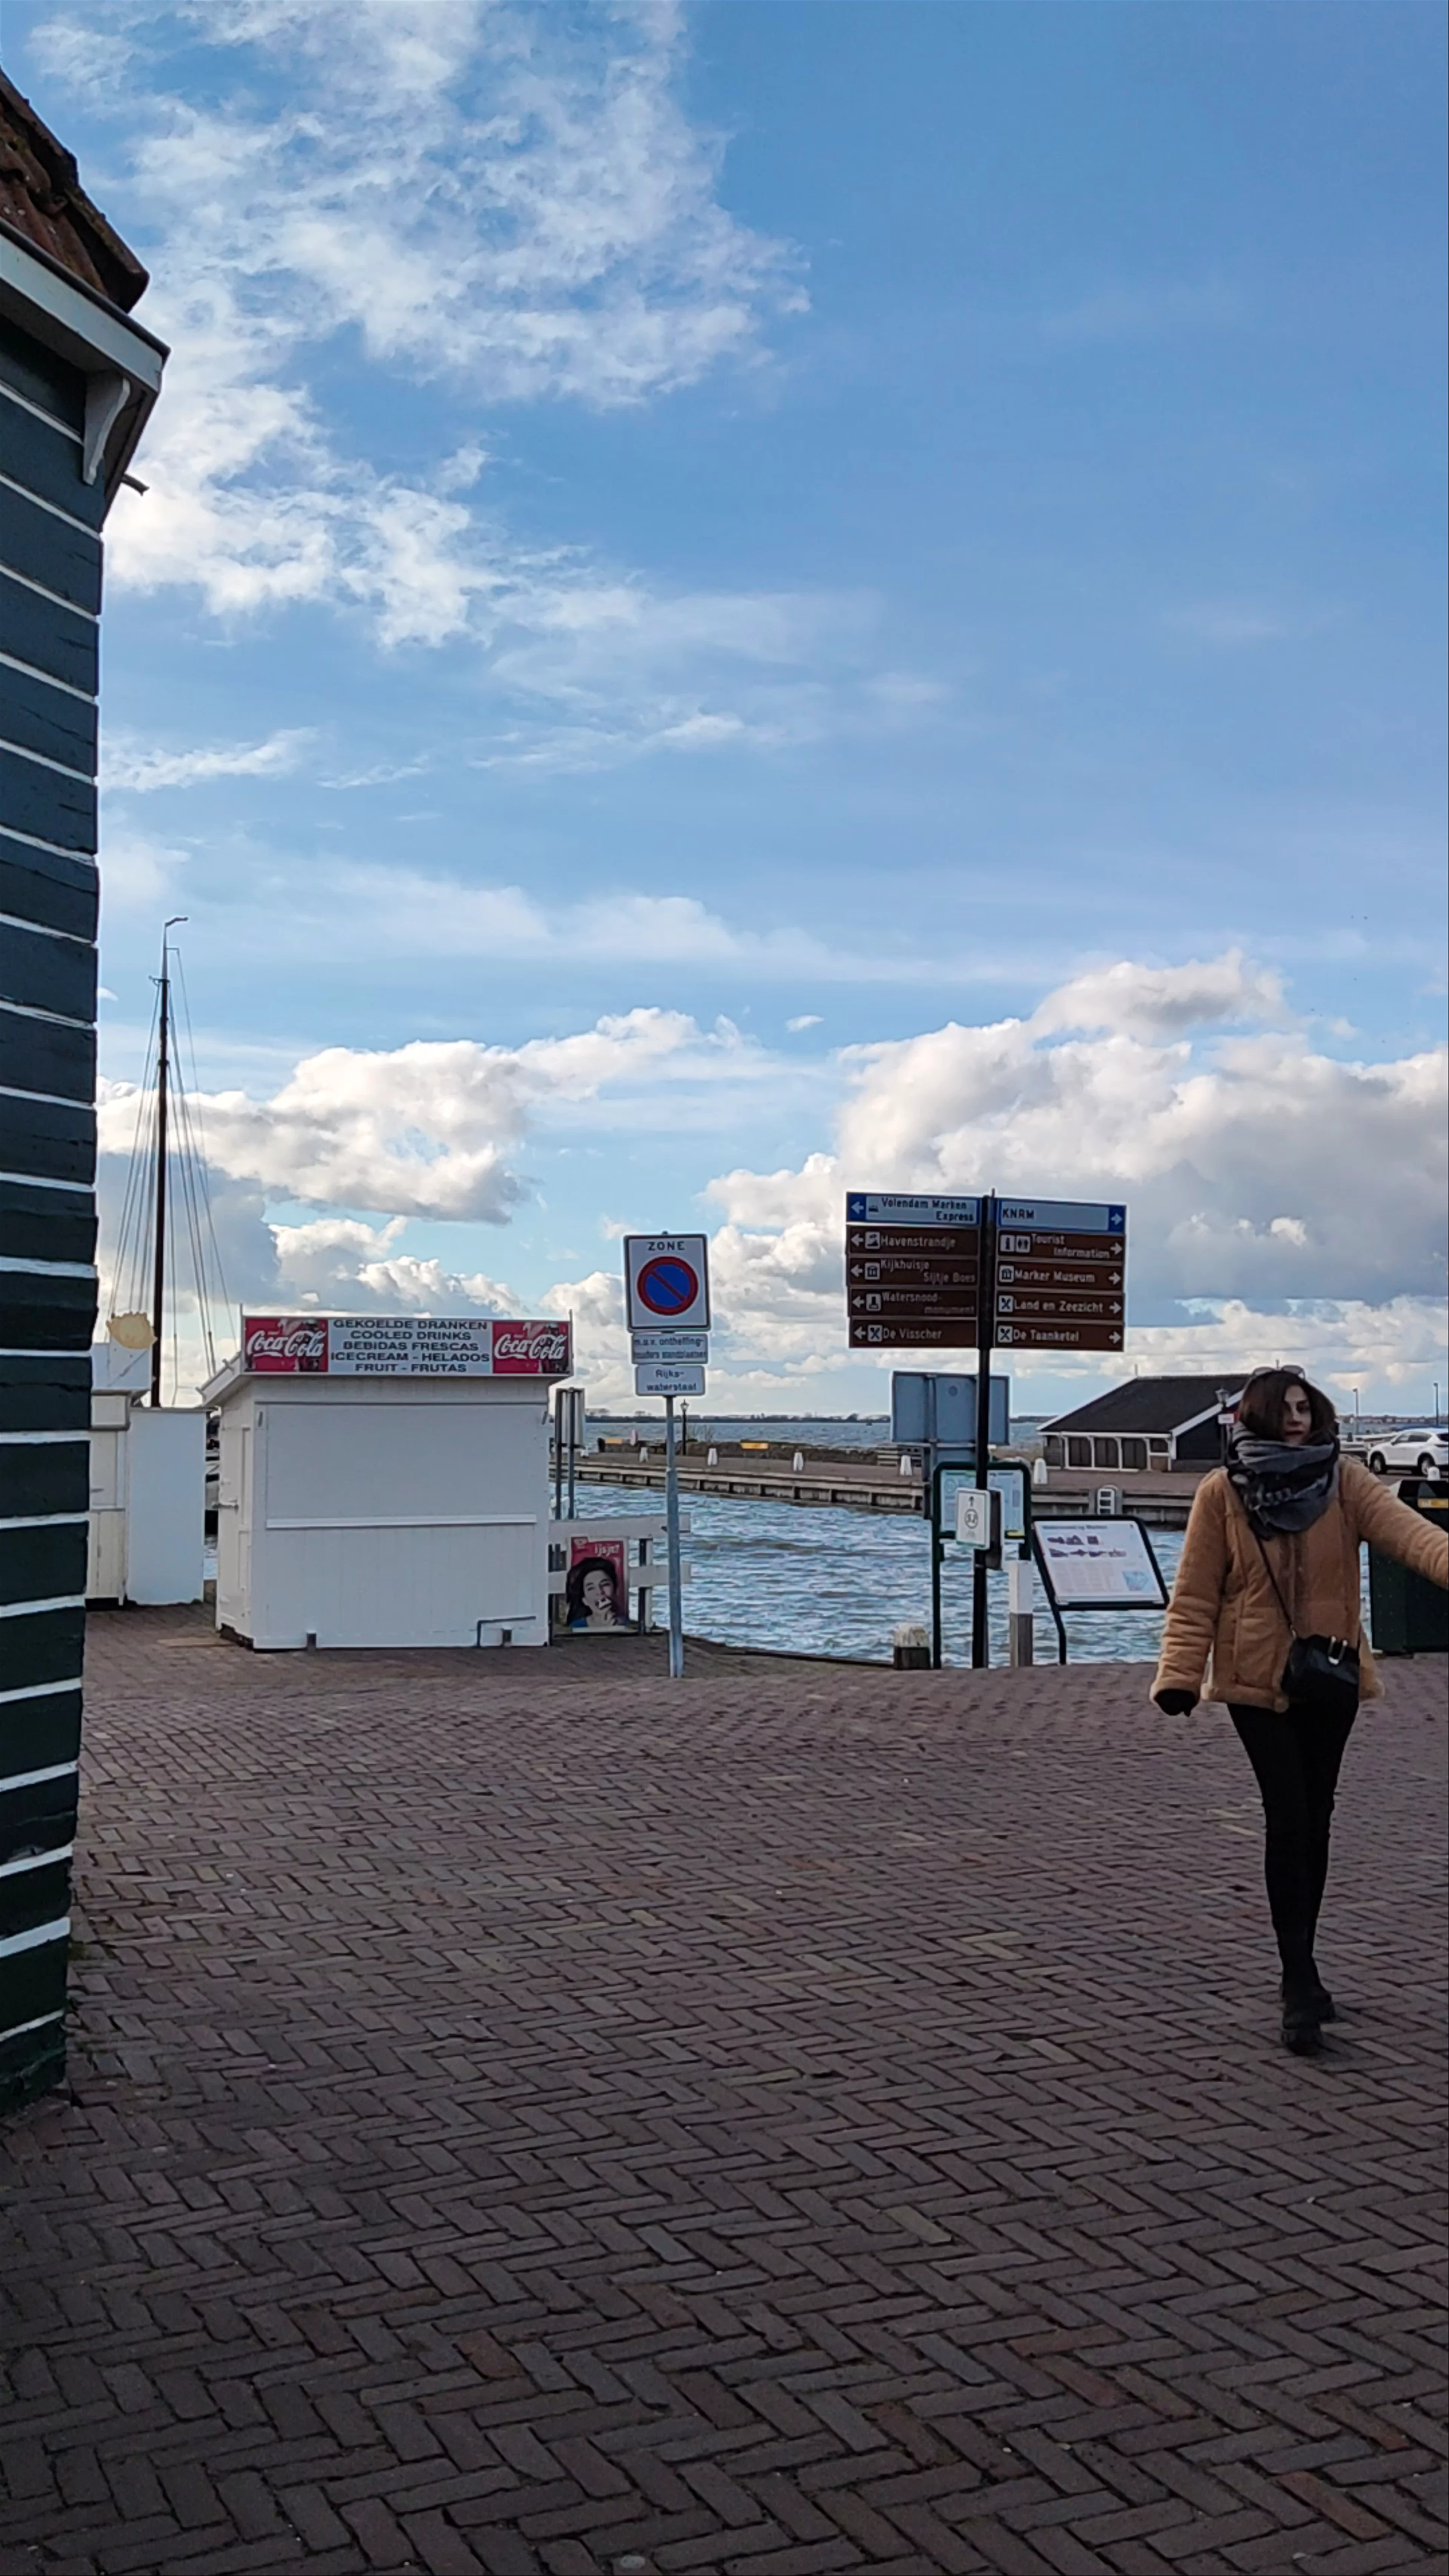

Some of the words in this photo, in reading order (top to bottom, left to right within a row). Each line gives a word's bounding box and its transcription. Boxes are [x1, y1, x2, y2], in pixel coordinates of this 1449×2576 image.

[881, 1197, 928, 1208] Volendam
[932, 1200, 967, 1210] Marken
[936, 1211, 974, 1222] Express
[1003, 1208, 1034, 1219] KNRM
[881, 1235, 956, 1250] Havenstrandje
[1031, 1233, 1065, 1244] Tourist
[647, 1241, 685, 1251] ZONE
[1054, 1247, 1109, 1258] Information
[881, 1259, 930, 1272] Kijkhuisje
[1015, 1269, 1051, 1281] Marker
[1054, 1271, 1095, 1283] Museum
[1015, 1299, 1040, 1311] Land
[1043, 1302, 1055, 1311] en
[1059, 1300, 1103, 1313] Zeezicht
[333, 1320, 413, 1329] GEKOELDE
[418, 1321, 487, 1330] DRANKEN
[351, 1330, 413, 1339] COOLED
[417, 1332, 471, 1340] DRINKS
[883, 1328, 896, 1339] De
[899, 1328, 942, 1339] Visscher
[1014, 1329, 1026, 1340] De
[343, 1341, 408, 1350] BEBIDAS
[412, 1342, 479, 1351] FRESCAS
[331, 1352, 409, 1361] ICECREAM
[422, 1353, 490, 1362] HELADOS
[411, 1364, 467, 1372] FRUTAS
